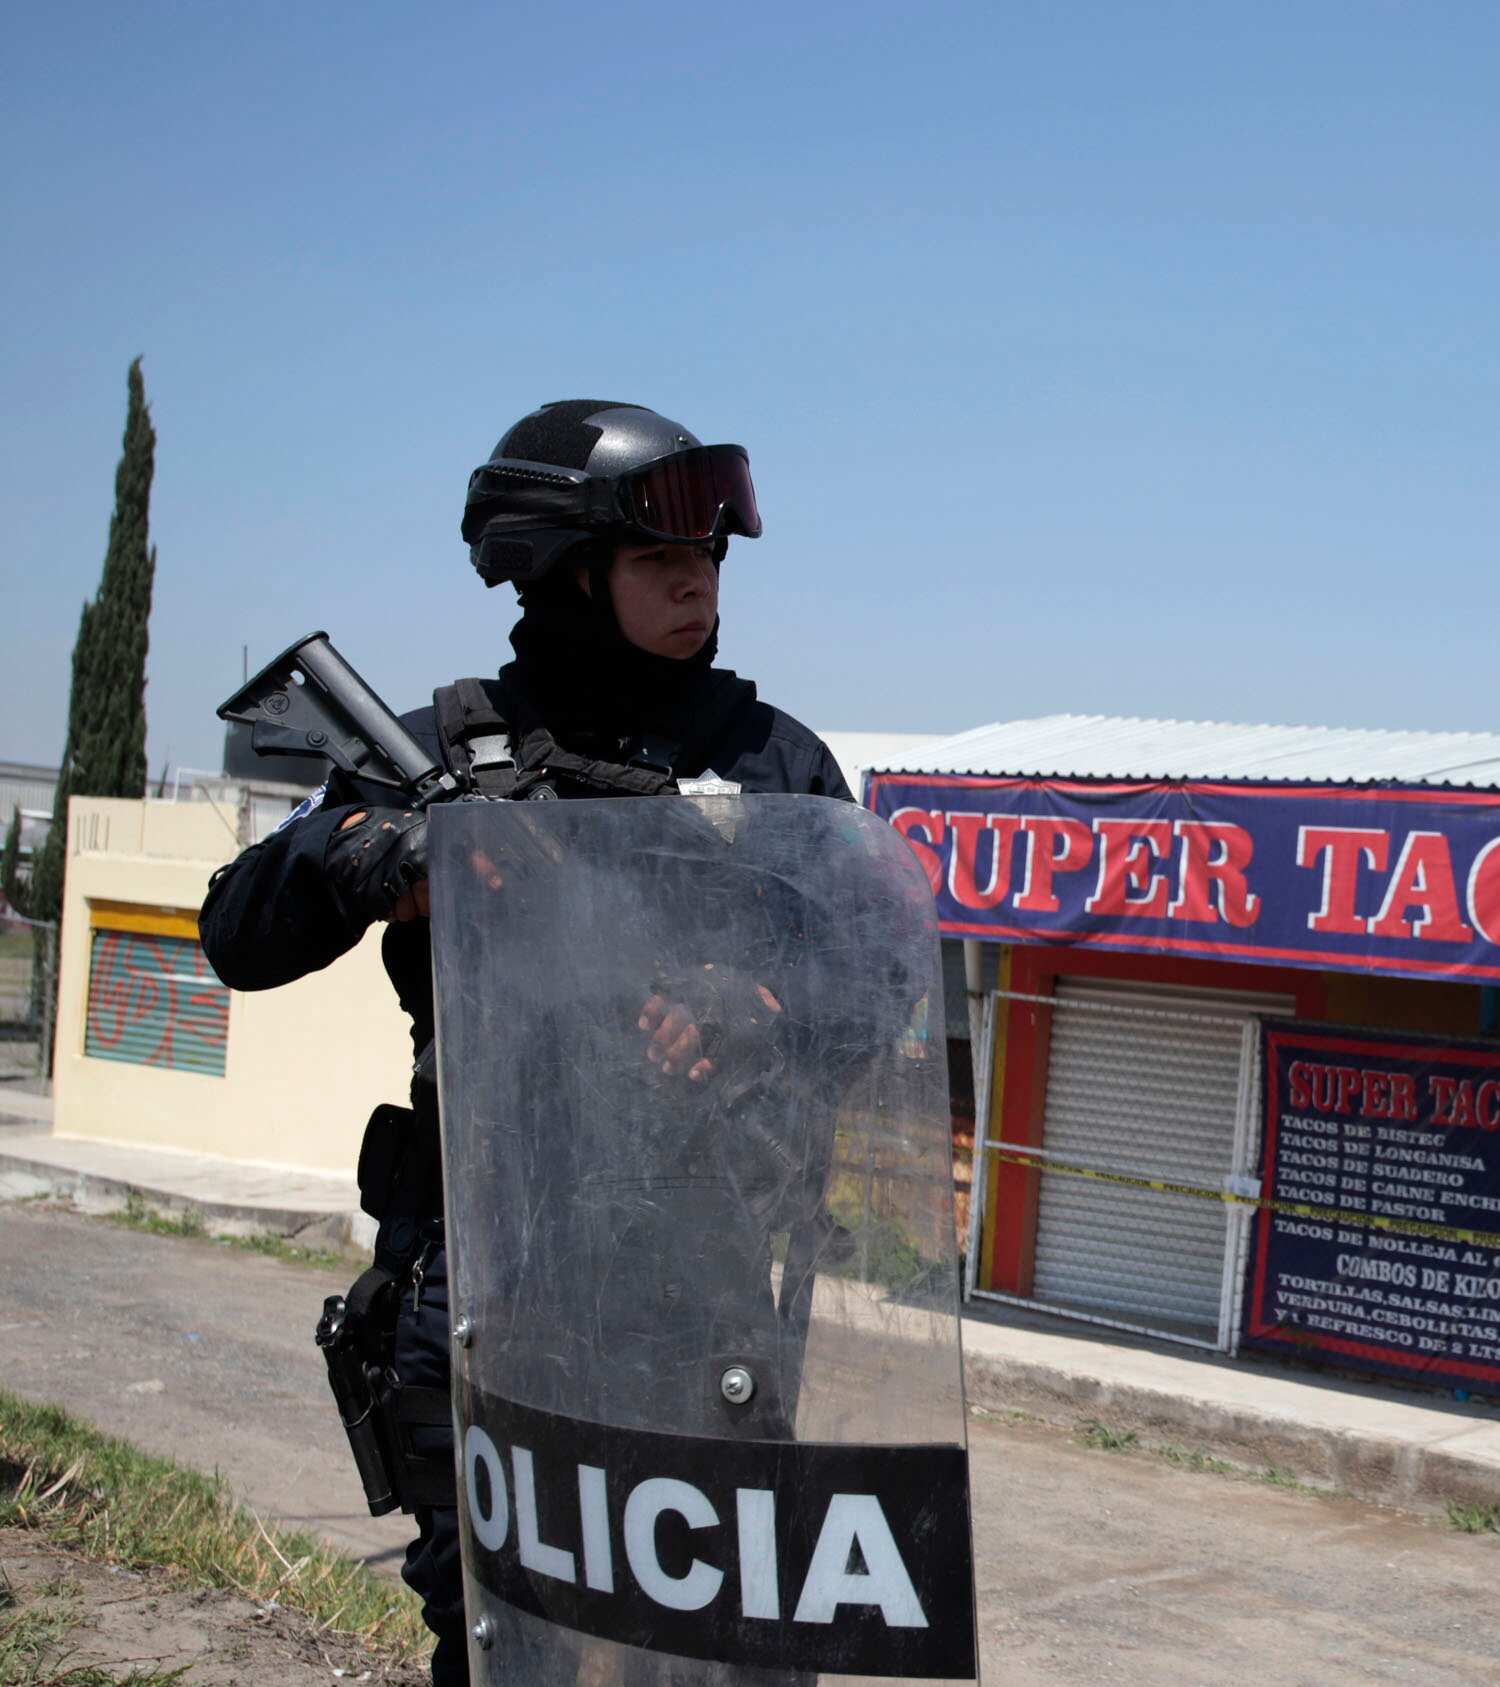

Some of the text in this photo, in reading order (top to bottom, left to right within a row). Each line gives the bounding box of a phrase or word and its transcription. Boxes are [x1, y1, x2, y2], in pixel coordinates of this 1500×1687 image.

[889, 805, 1260, 929] SUPER
[1288, 1060, 1419, 1121] SUPER
[1280, 1114, 1447, 1148] TACOS DE BISTEC
[1279, 1150, 1465, 1188] TACOS DE SUADERO
[1280, 1132, 1486, 1172] TACOS DE LONGANISA
[1276, 1185, 1336, 1206] TACOS
[1340, 1194, 1367, 1210] DE
[1371, 1199, 1446, 1222] PASTOR
[1278, 1167, 1337, 1188] TACOS
[1341, 1176, 1367, 1192] DE
[1371, 1181, 1436, 1203] CARNE
[1274, 1219, 1334, 1242] TACOS
[1337, 1230, 1364, 1246] DE
[1368, 1235, 1458, 1262] MOLLEJA
[1461, 1250, 1488, 1267] AL
[1336, 1253, 1418, 1288] COMBOS
[1421, 1268, 1450, 1293] DE
[1273, 1307, 1289, 1322] Y
[1307, 1313, 1414, 1347] REFRESCO
[1418, 1335, 1447, 1352] DE
[1451, 1341, 1464, 1355] 2
[464, 1424, 930, 1629] OLICIA
